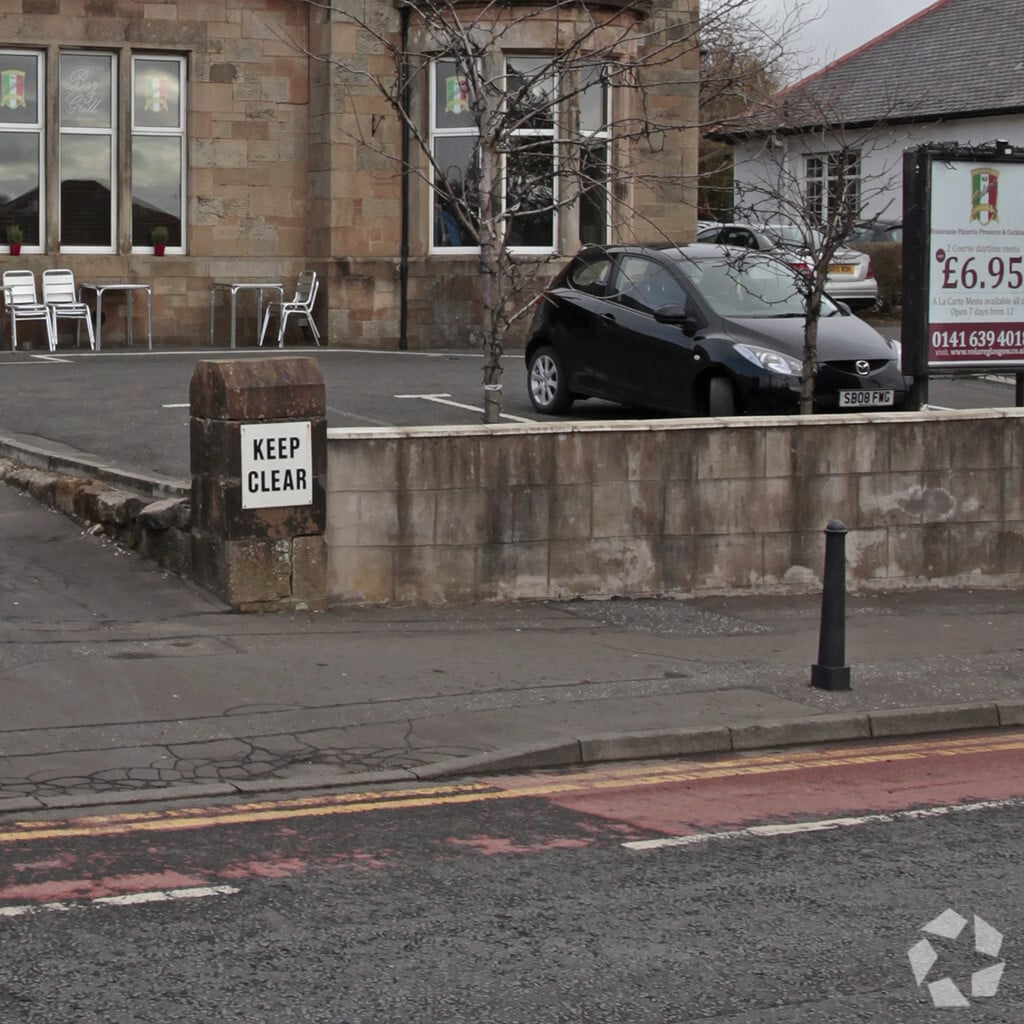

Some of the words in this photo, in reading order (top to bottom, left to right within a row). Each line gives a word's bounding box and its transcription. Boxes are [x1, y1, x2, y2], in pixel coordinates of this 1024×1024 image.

[942, 256, 1023, 289] £6.95
[947, 297, 964, 305] Carte
[965, 297, 983, 305] Menu
[984, 296, 1012, 305] available
[950, 307, 968, 317] Open
[974, 307, 989, 317] days
[1006, 307, 1014, 316] 12
[932, 331, 966, 348] 0141
[968, 330, 995, 347] 639
[996, 330, 1024, 346] 401
[844, 391, 871, 404] SB08
[253, 437, 300, 460] KEEP
[248, 468, 307, 493] CLEAR
